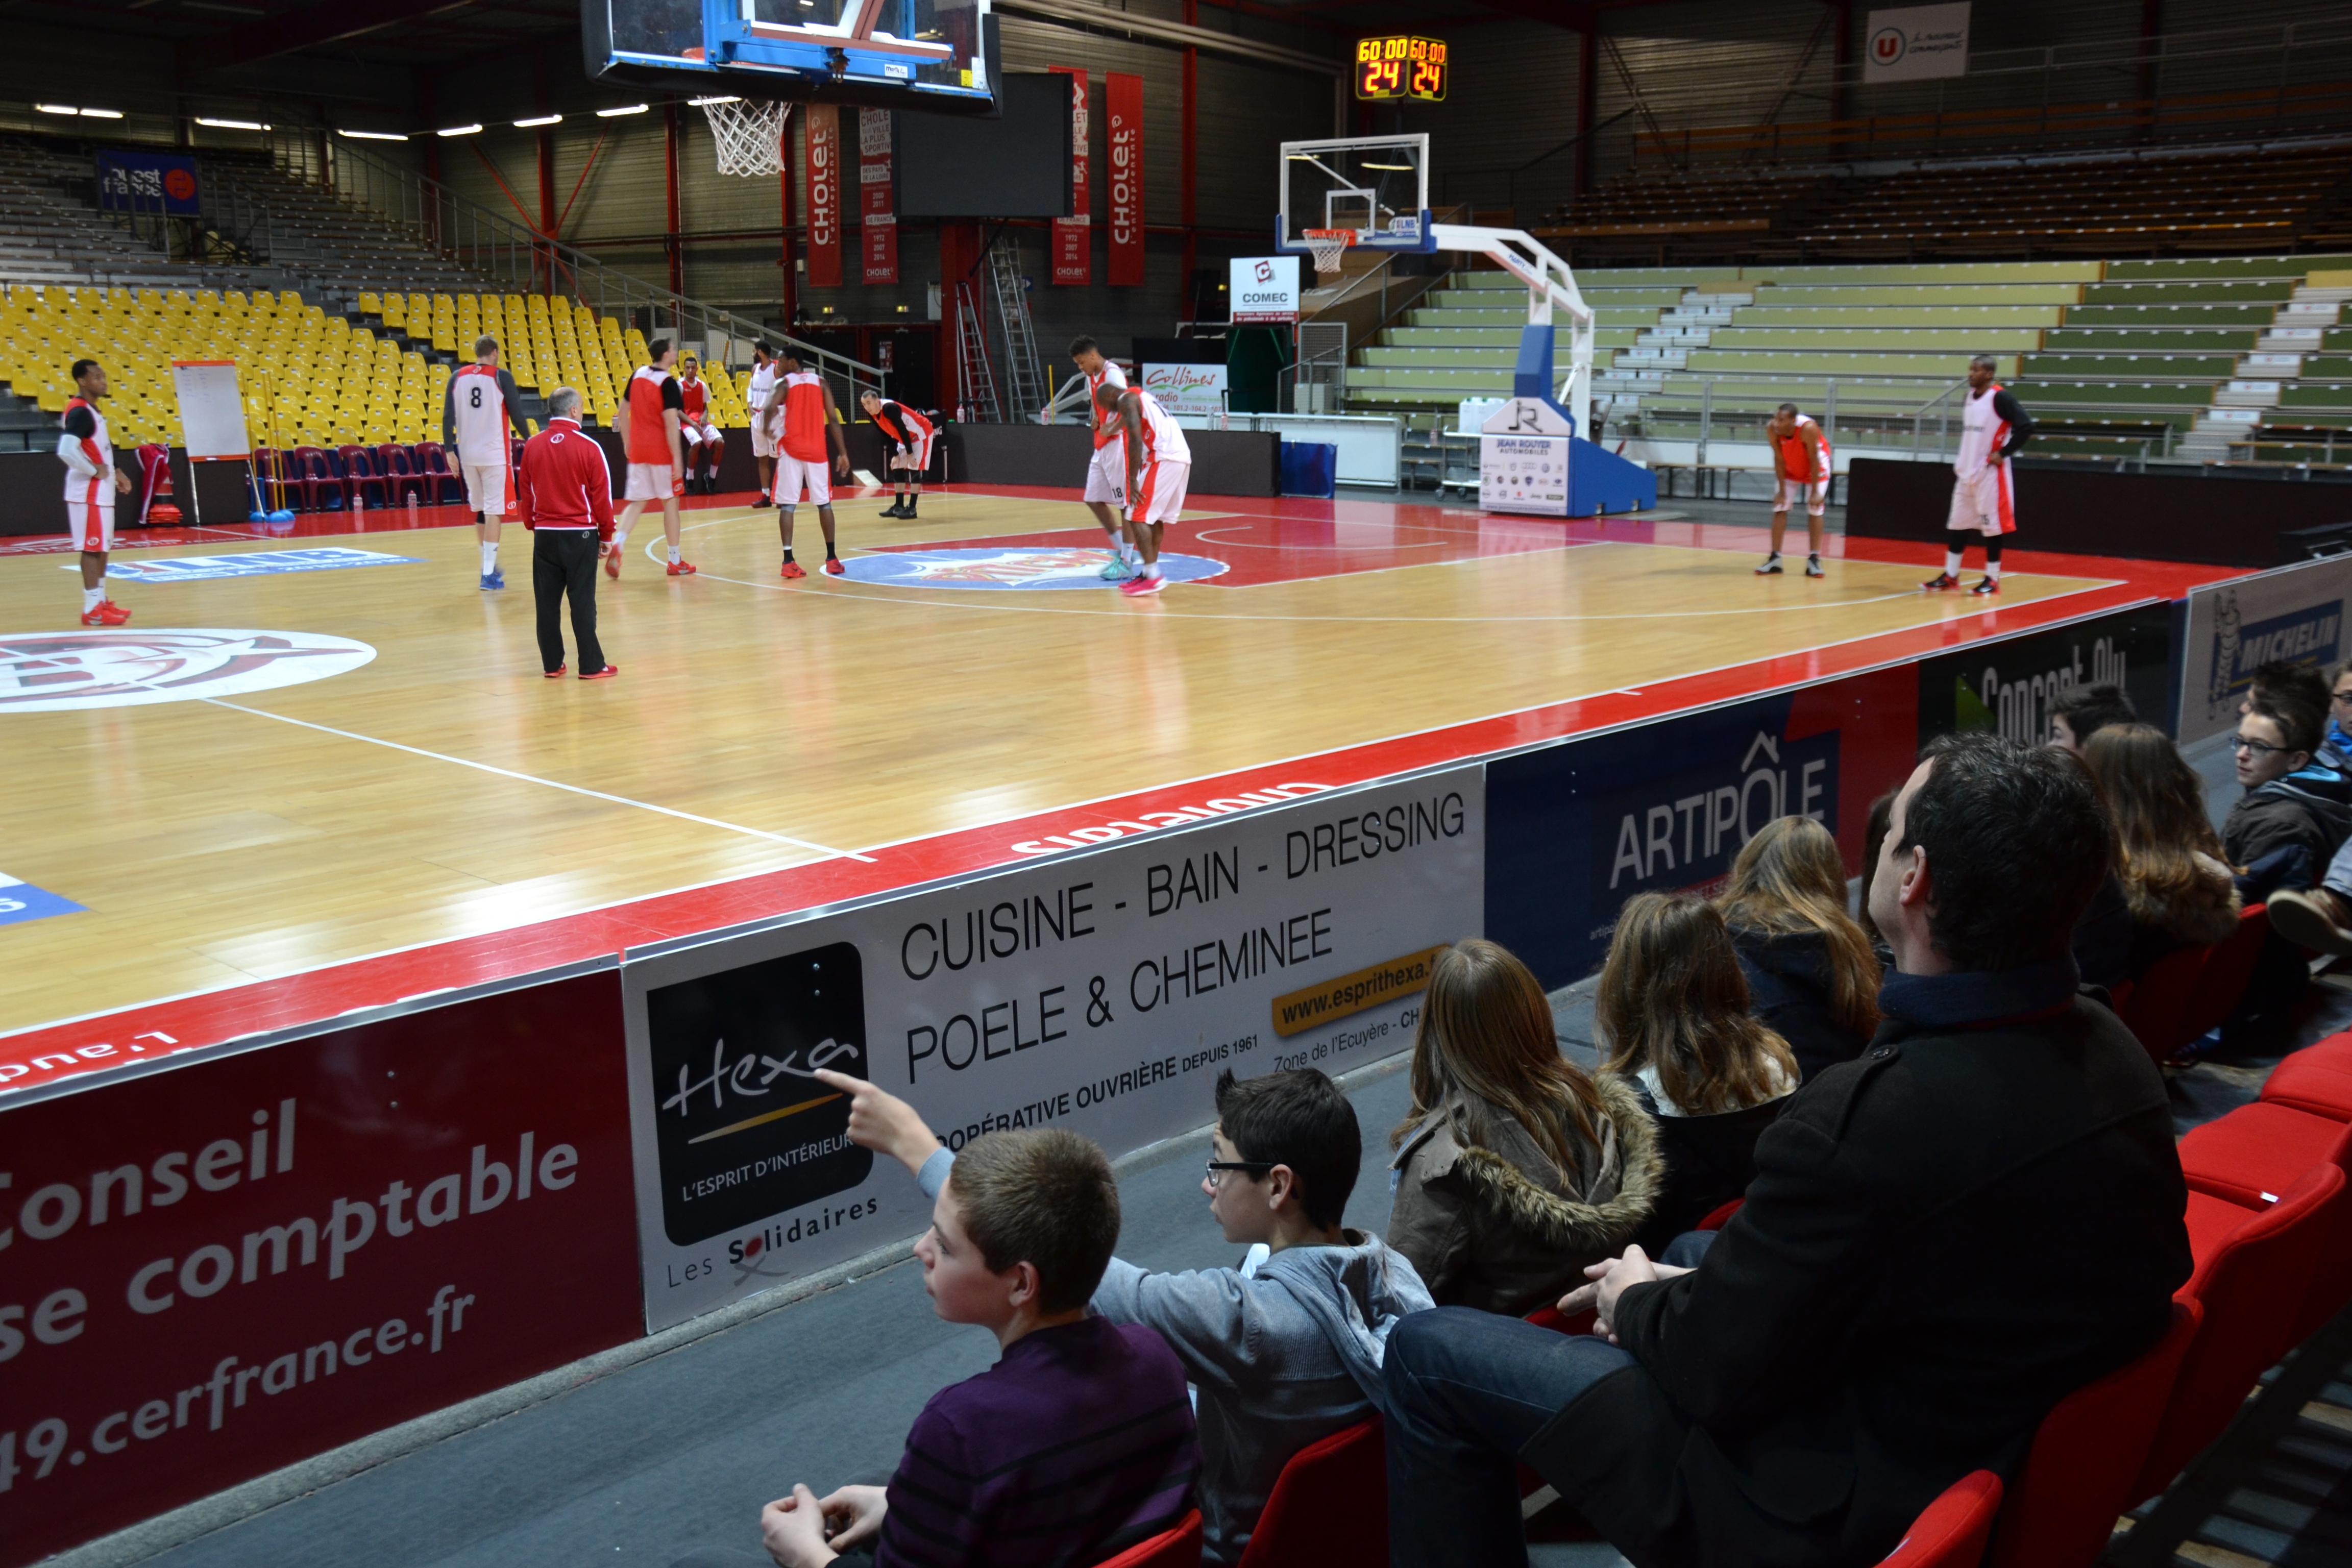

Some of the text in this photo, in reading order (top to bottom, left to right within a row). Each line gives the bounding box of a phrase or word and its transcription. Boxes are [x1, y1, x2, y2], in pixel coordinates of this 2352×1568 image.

[1365, 61, 1399, 92] 24
[1414, 61, 1440, 92] 24
[865, 143, 890, 153] SPORTIV
[870, 134, 885, 142] PLUS
[1242, 292, 1288, 303] COMEC
[1146, 366, 1216, 386] Collines
[471, 386, 481, 408] 8
[1156, 392, 1178, 402] radio
[1519, 440, 1551, 449] ROUYER
[1112, 487, 1123, 499] 18
[2239, 614, 2340, 673] MICHELIN
[901, 882, 1096, 981] CUISINE
[1147, 846, 1240, 917] BAIN
[1287, 793, 1464, 880] DRESSING
[907, 908, 1332, 1084] POELE & CHEMINEE
[1274, 1050, 1308, 1072] Zone
[1312, 1043, 1328, 1061] de
[1332, 1022, 1389, 1054] l'Ecuyère
[662, 1037, 859, 1117] Hexa
[1076, 1057, 1178, 1109] OUVRIÈRE
[1182, 1044, 1229, 1072] DEPUIS
[1233, 1034, 1258, 1055] 1961
[682, 1132, 854, 1202] L'ESPRIT D'INTÉRIEUR
[127, 1131, 578, 1315] comptable
[667, 1254, 713, 1289] Les
